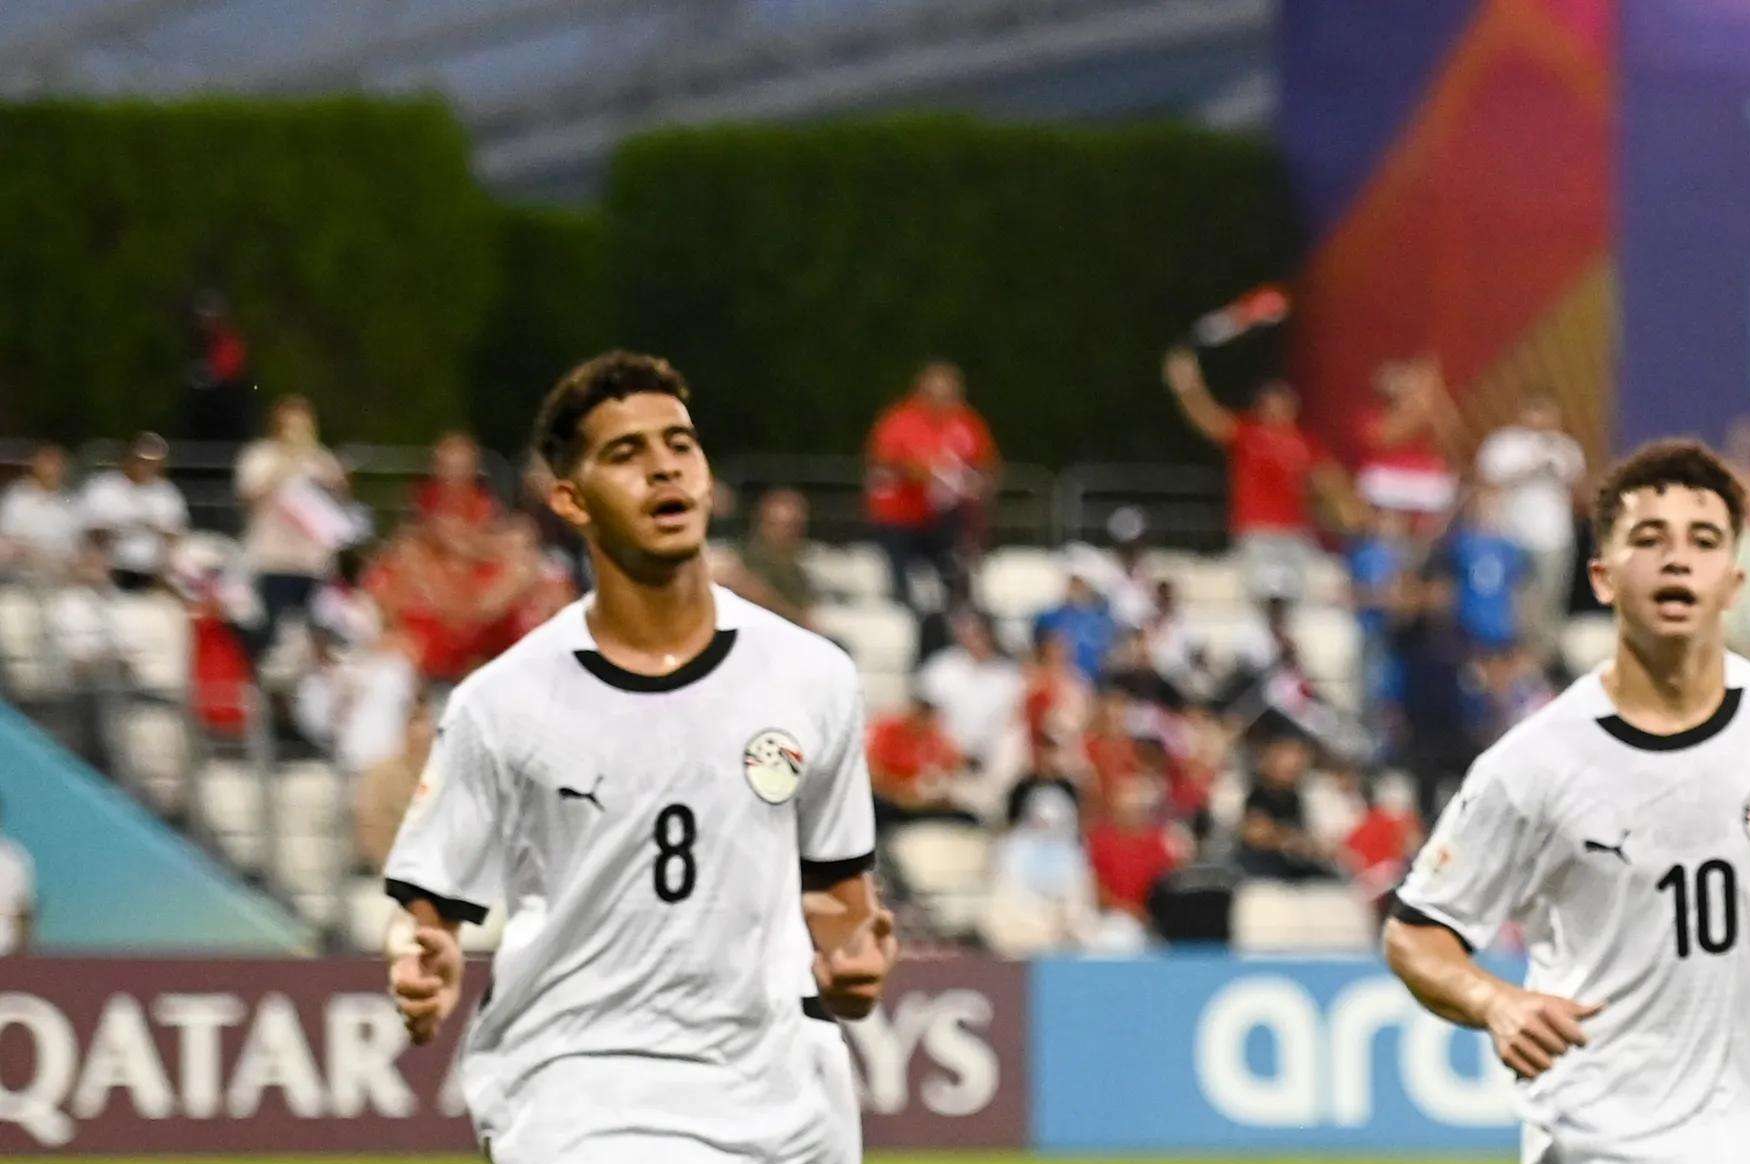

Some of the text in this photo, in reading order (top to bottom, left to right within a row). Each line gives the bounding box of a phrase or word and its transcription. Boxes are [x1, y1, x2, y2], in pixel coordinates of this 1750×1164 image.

[653, 803, 697, 903] 8
[1657, 859, 1737, 958] 10
[0, 990, 419, 1146] QATAR
